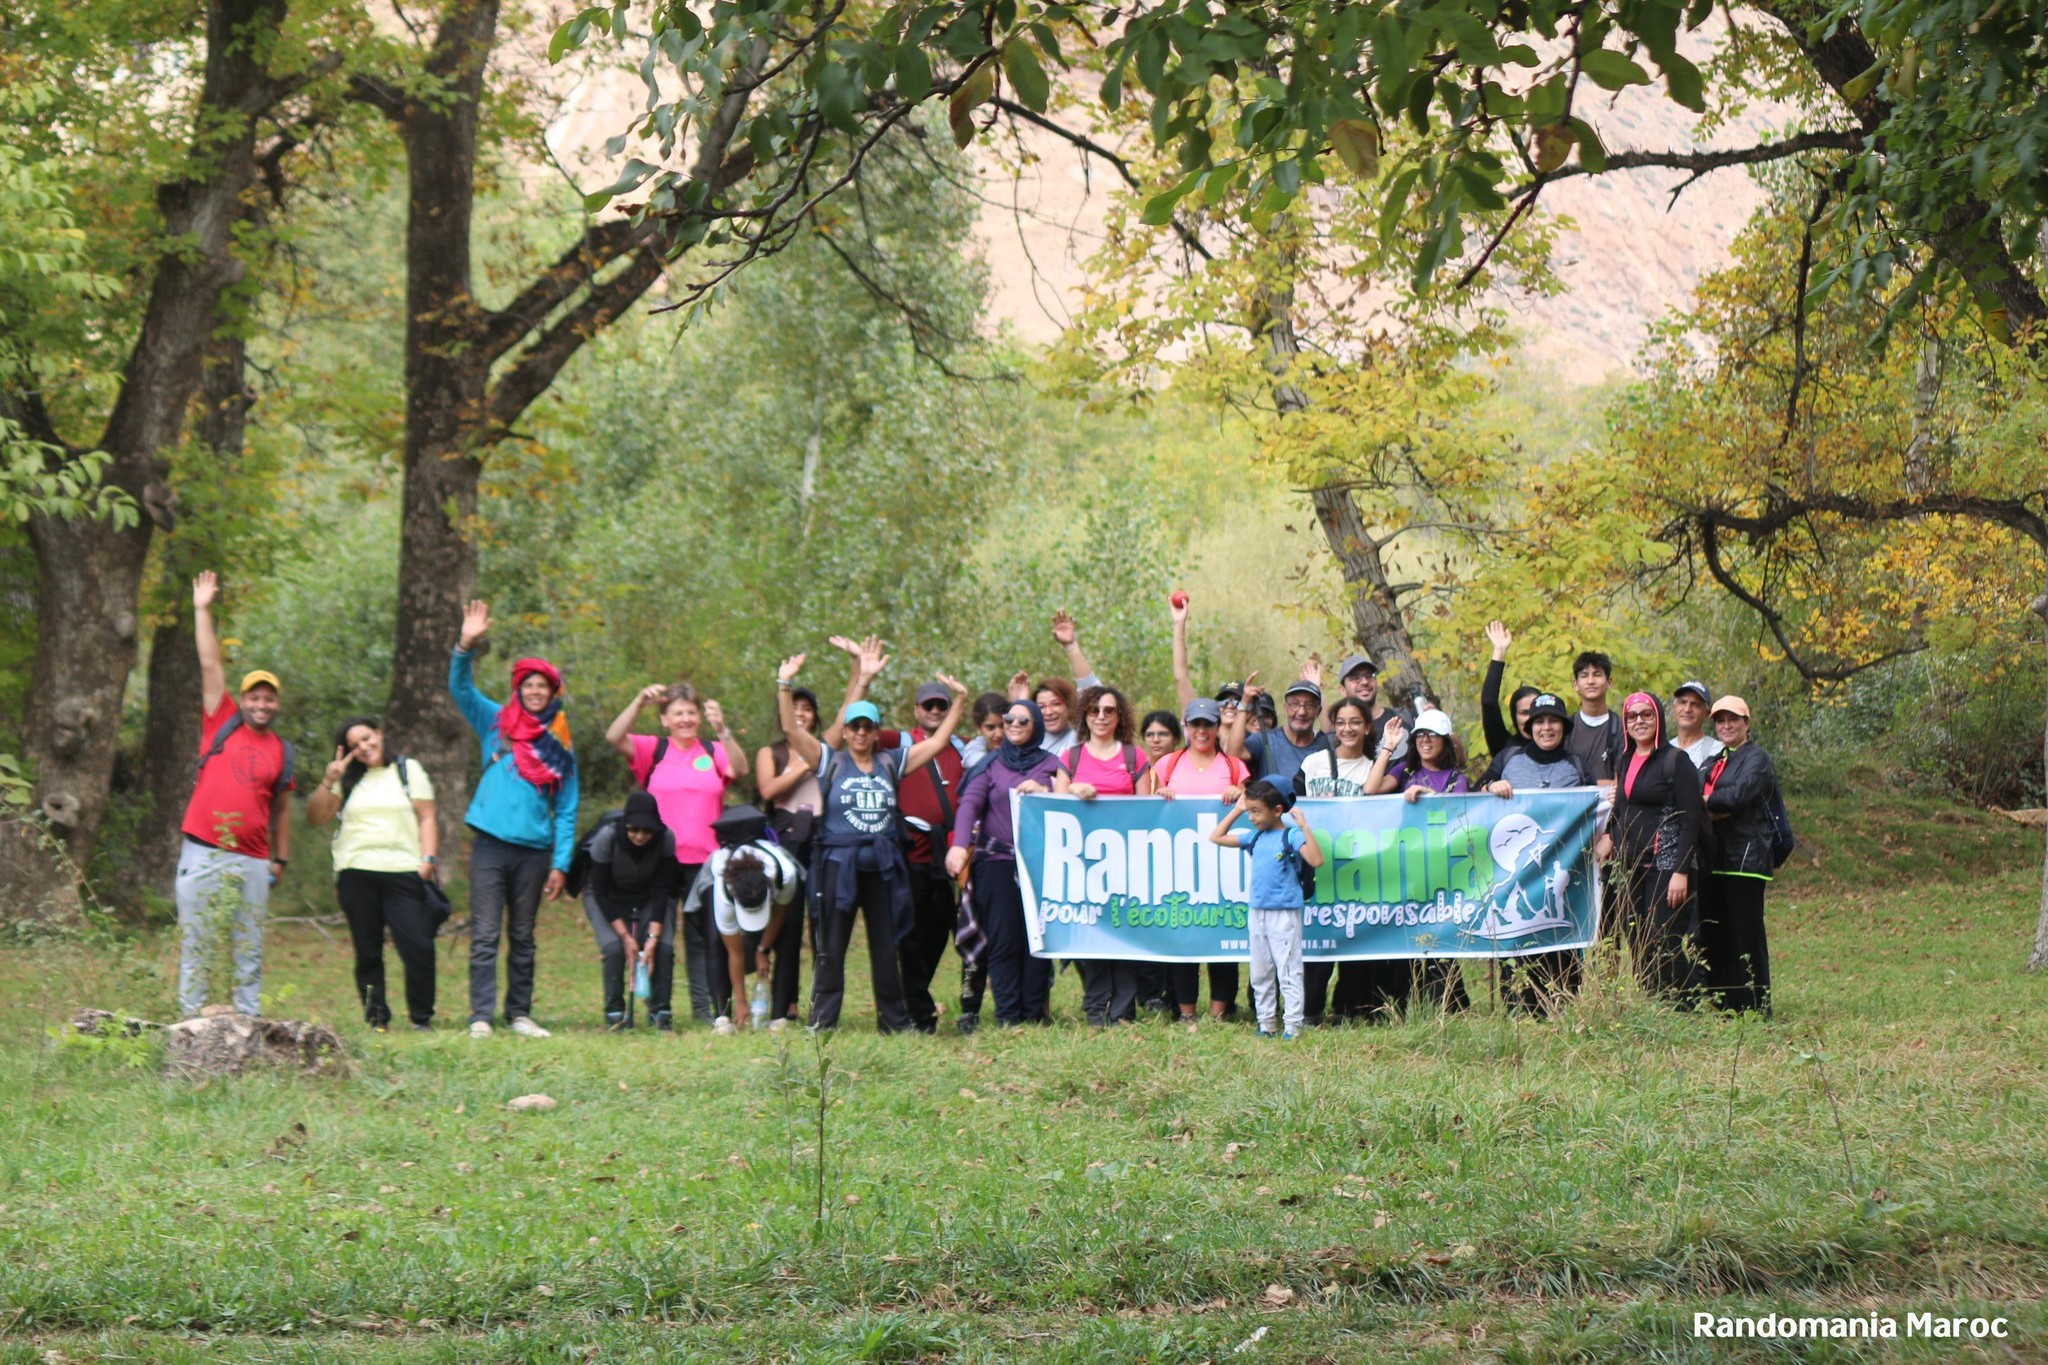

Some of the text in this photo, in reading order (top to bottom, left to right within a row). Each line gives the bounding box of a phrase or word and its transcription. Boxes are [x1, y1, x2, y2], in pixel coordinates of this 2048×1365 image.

[856, 791, 884, 809] GAP
[843, 809, 891, 833] FINEST QUALITY
[1039, 900, 1103, 935] pour
[1303, 891, 1476, 938] responsable
